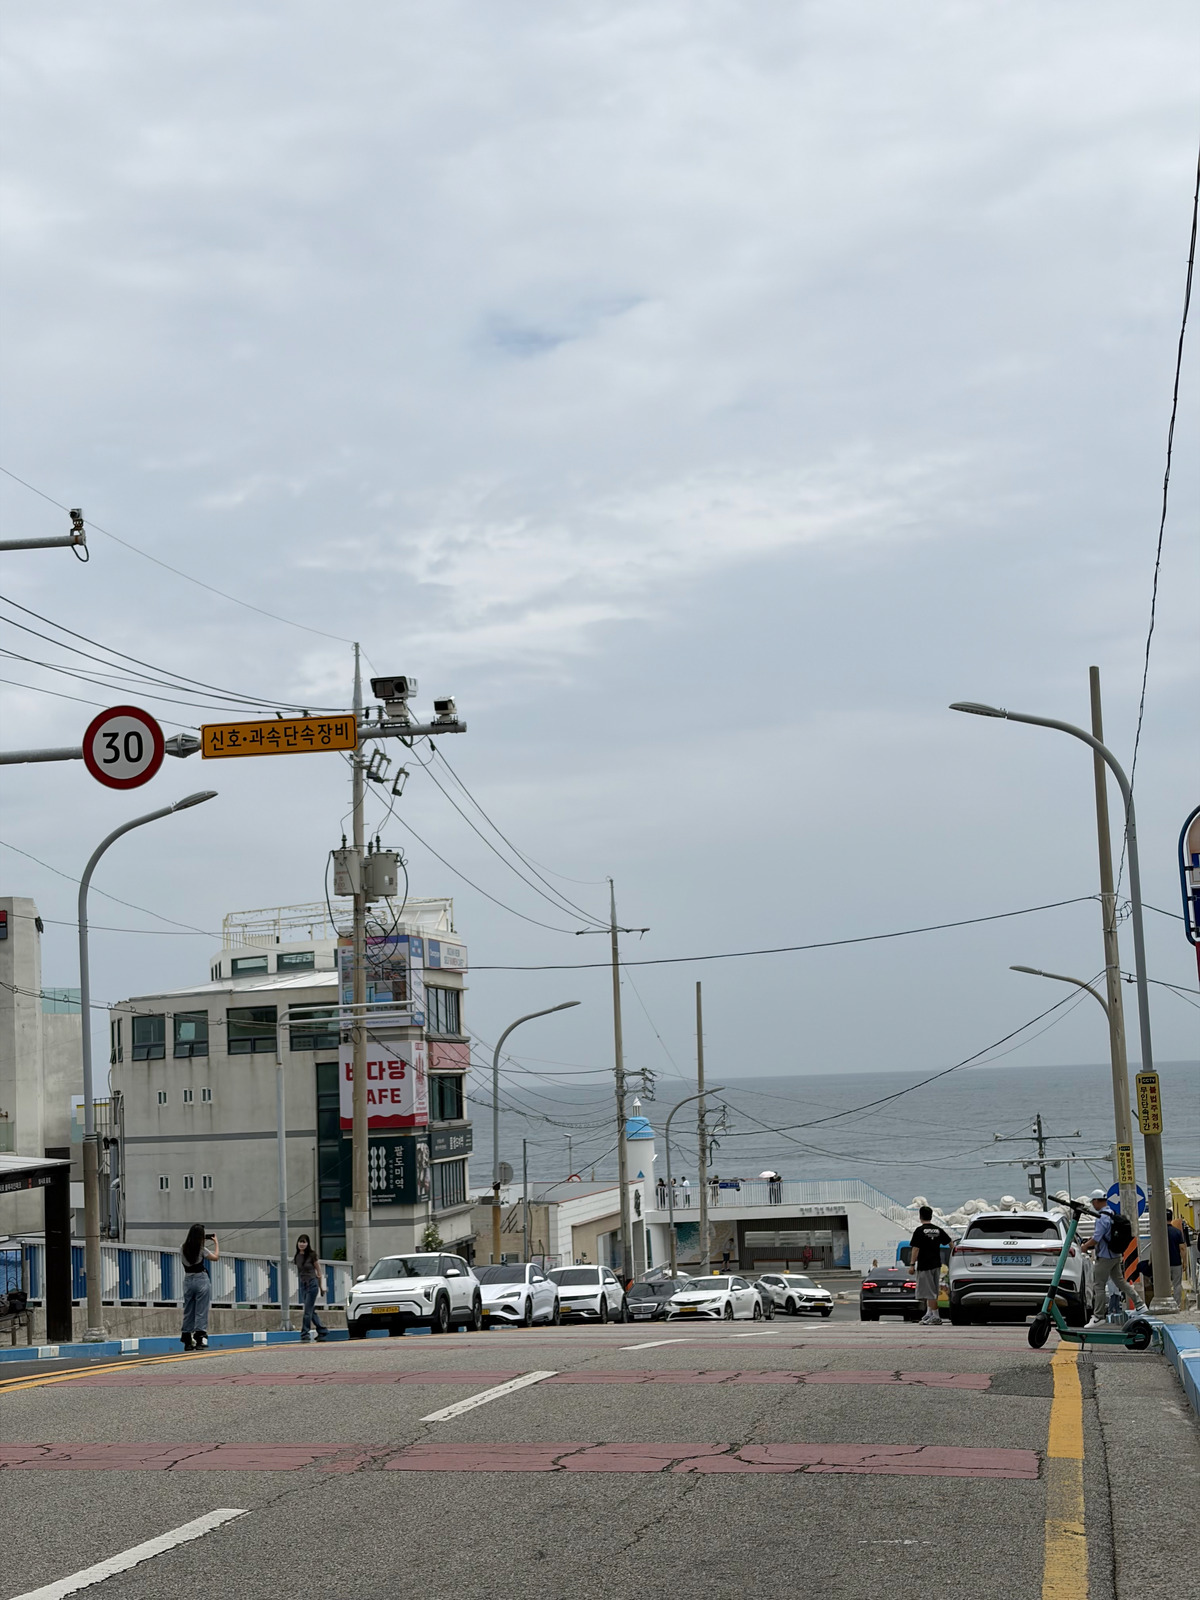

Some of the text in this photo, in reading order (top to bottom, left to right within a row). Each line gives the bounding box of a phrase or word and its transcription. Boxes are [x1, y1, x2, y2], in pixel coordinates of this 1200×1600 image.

[102, 731, 143, 764] 30
[210, 722, 349, 751] 신호·과속단속장비
[366, 1088, 402, 1104] AFE
[1140, 1086, 1151, 1131] 무인단속구간
[1149, 1086, 1160, 1131] 불법주정차
[394, 1145, 405, 1189] 팔도미역
